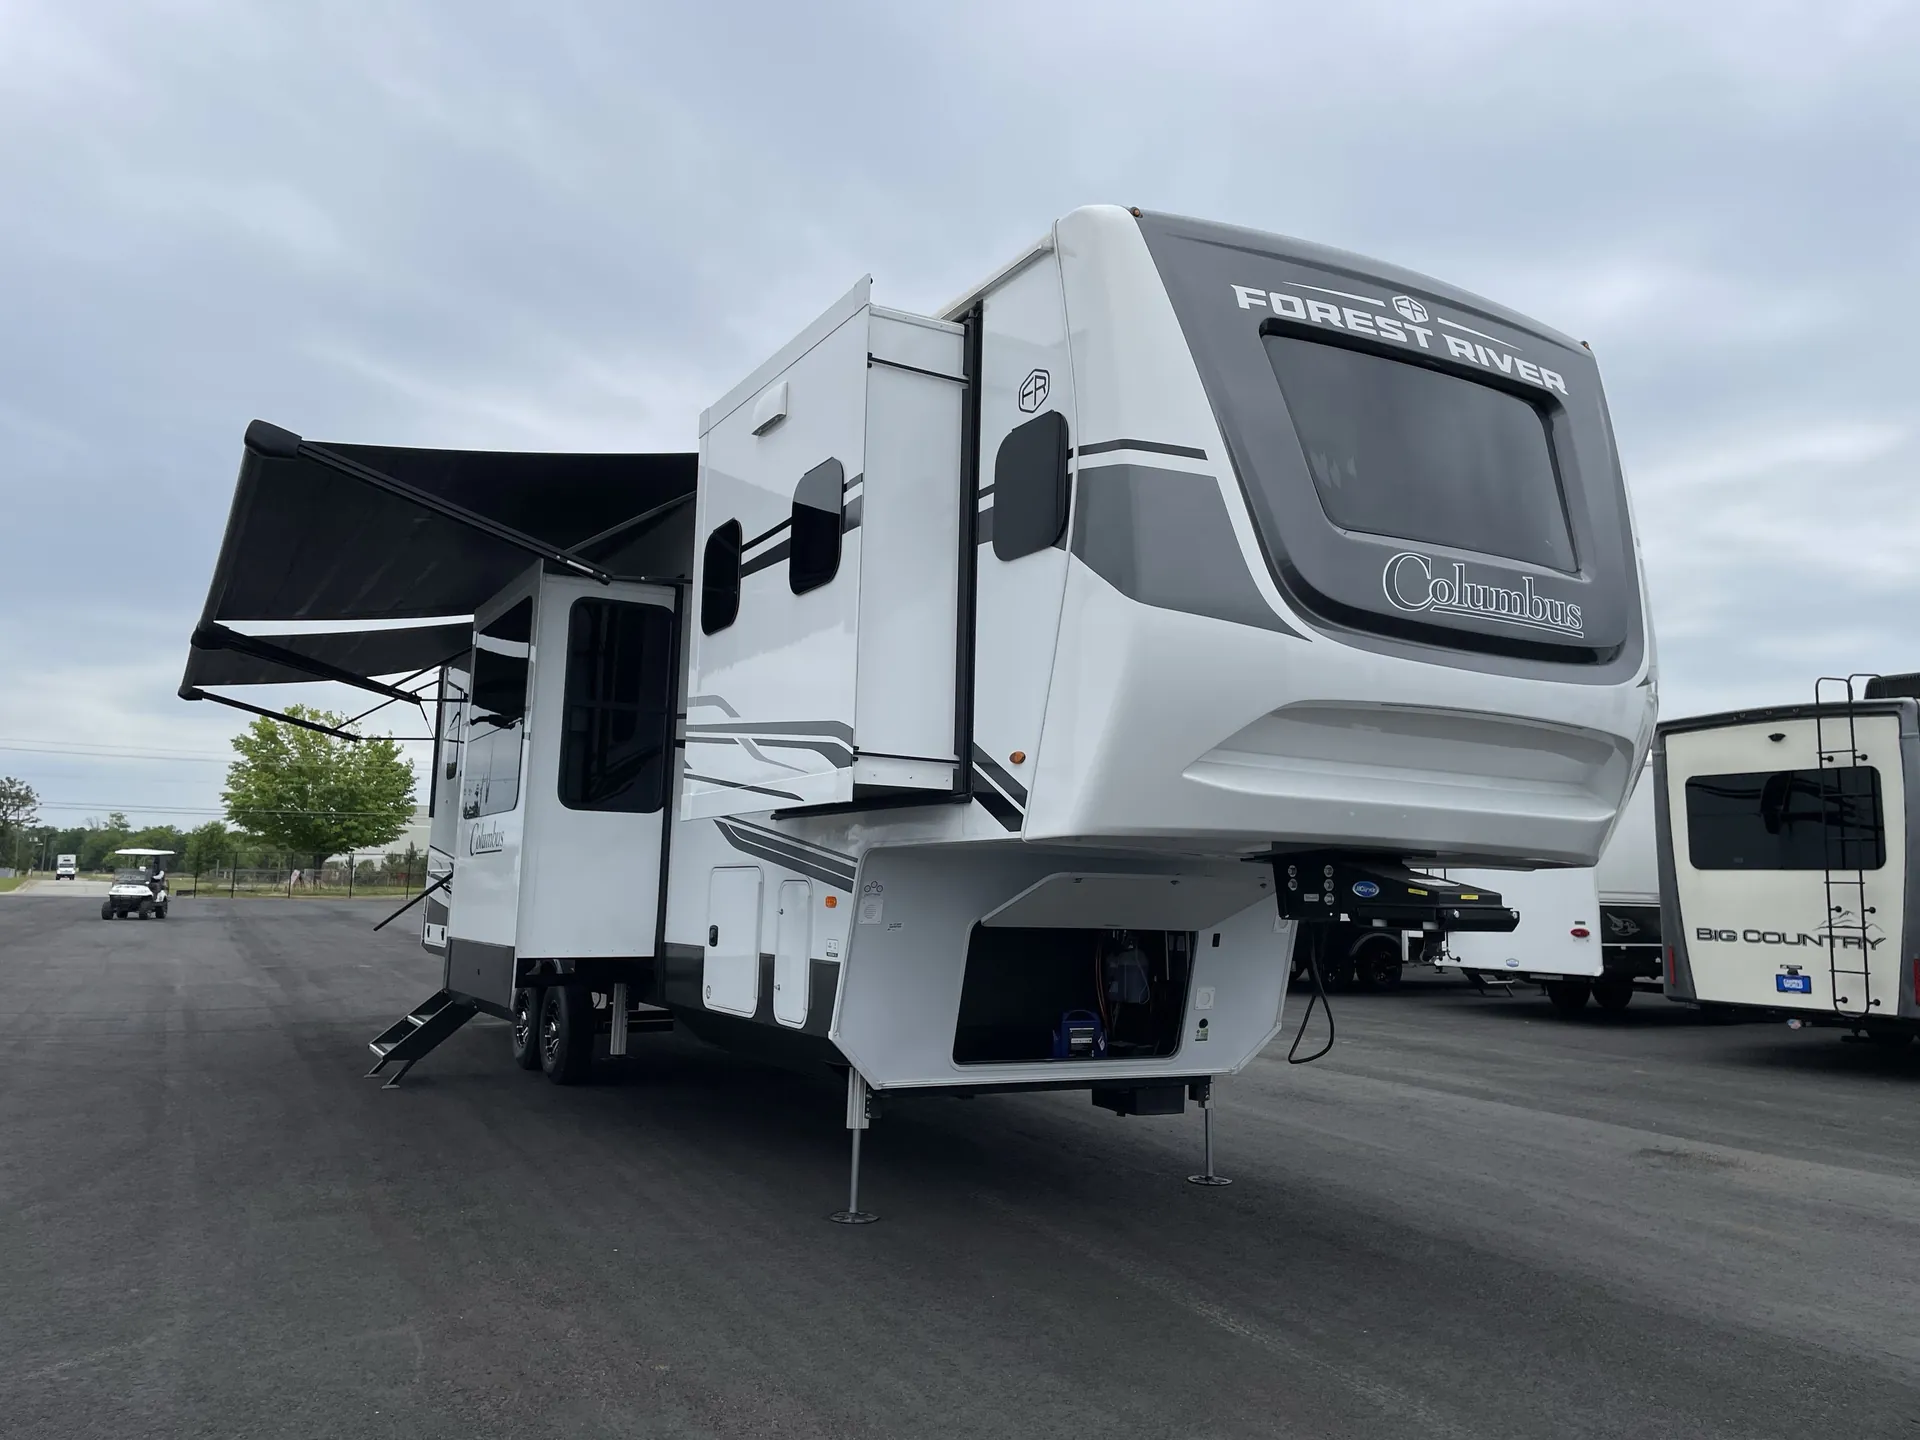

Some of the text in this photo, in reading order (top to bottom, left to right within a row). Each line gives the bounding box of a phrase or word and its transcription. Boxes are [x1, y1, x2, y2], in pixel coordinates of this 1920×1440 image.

[1230, 284, 1569, 396] FOREST RIVER
[1383, 552, 1583, 630] Columbus
[469, 820, 505, 856] Columbus
[1696, 928, 1887, 951] BIG COUNTRY
